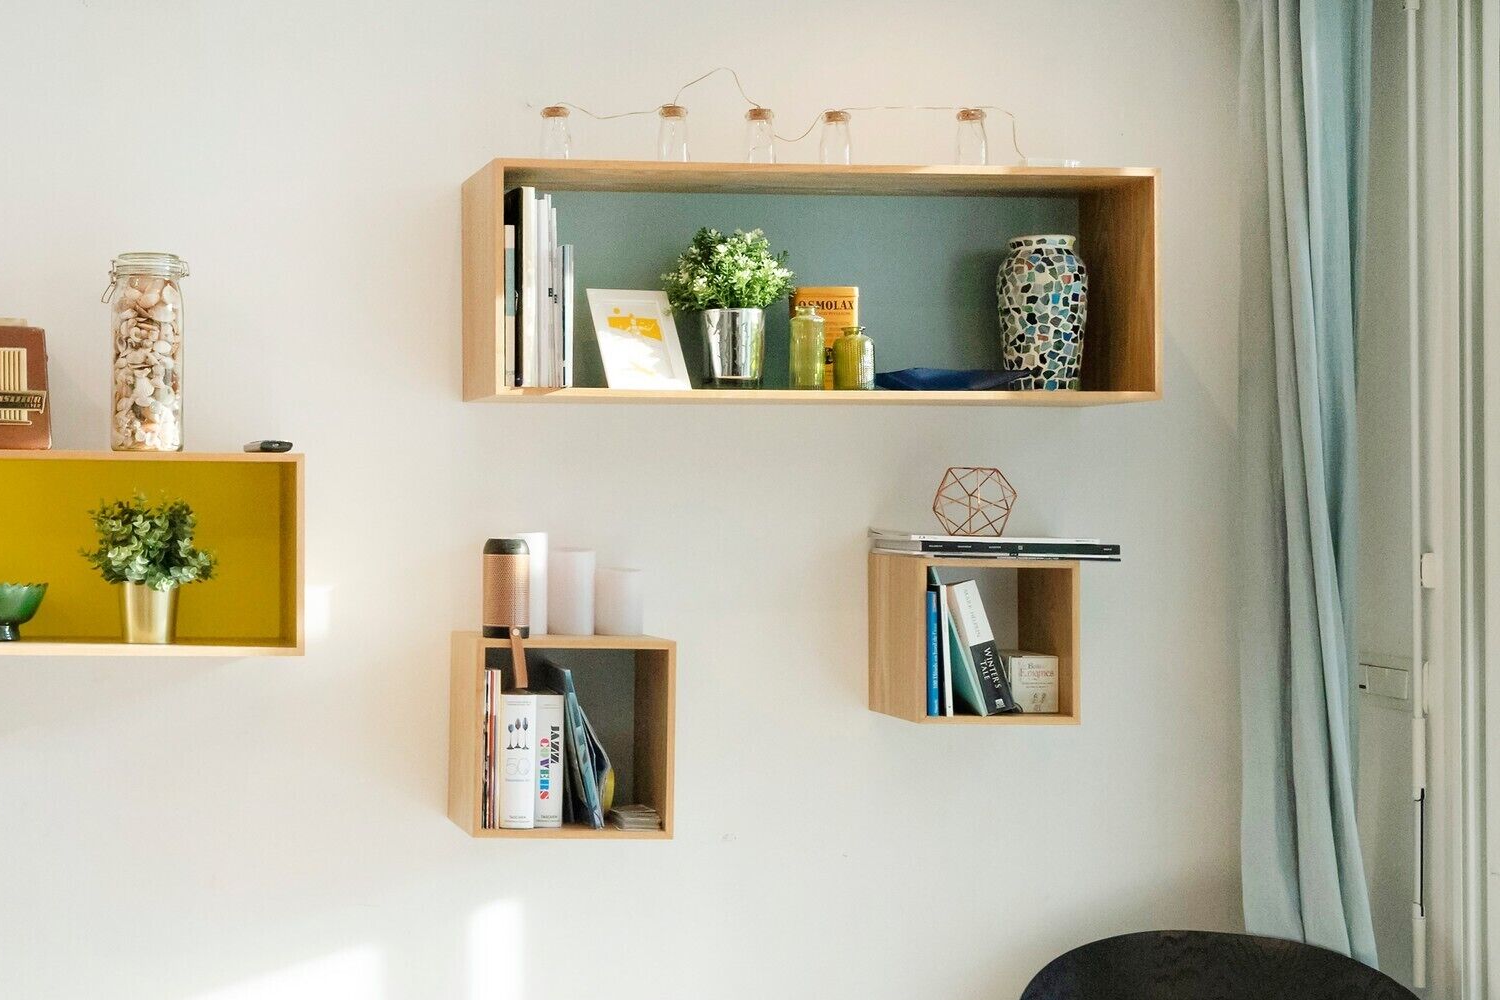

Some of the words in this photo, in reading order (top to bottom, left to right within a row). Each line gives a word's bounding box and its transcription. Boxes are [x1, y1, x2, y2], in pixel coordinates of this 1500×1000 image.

[980, 660, 991, 681] TALE
[984, 647, 1002, 689] WINTER'S
[540, 738, 550, 800] COVERS
